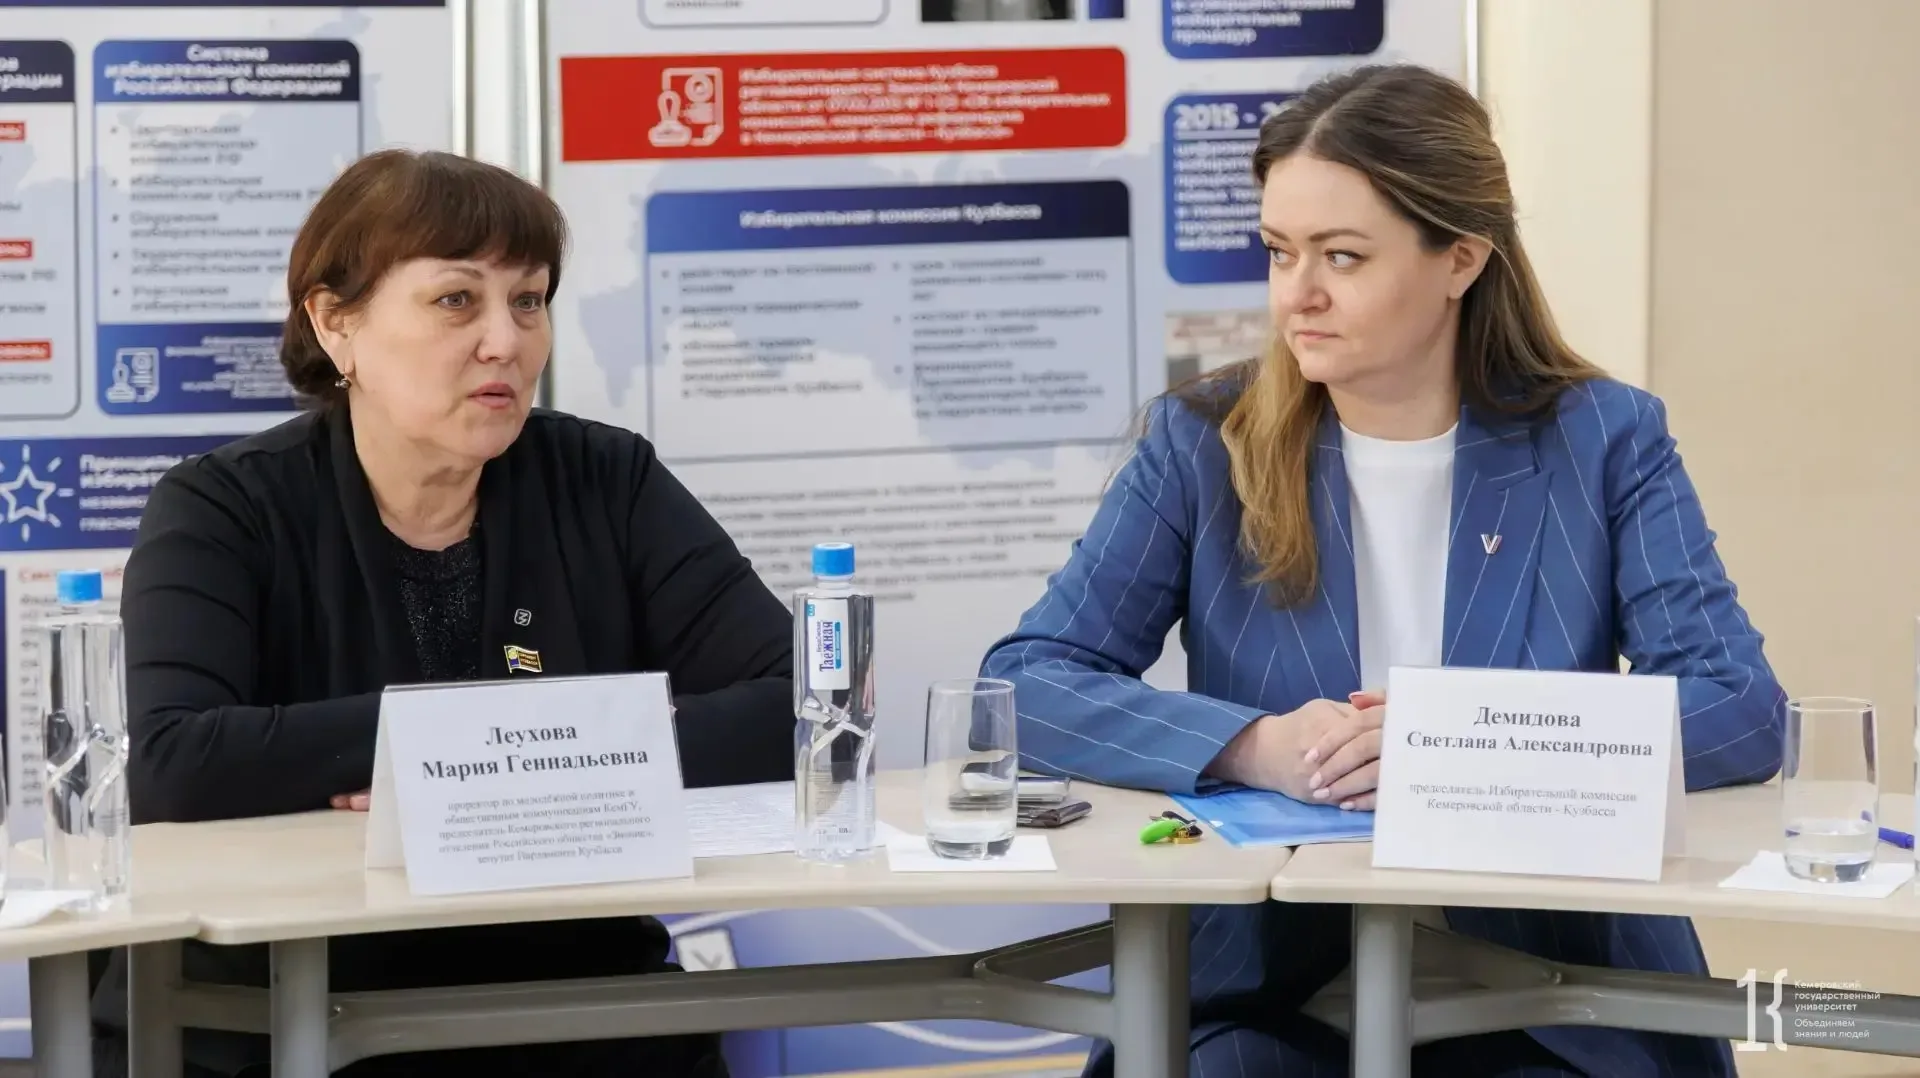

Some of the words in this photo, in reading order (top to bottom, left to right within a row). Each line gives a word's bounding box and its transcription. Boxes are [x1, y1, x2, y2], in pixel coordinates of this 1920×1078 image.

[1172, 28, 1257, 46] процедур
[187, 43, 269, 62] Система
[104, 61, 253, 79] избирательных
[255, 60, 350, 78] комиссий
[114, 78, 229, 95] Российской
[231, 78, 342, 98] Федерации
[1174, 103, 1239, 129] 2015
[740, 211, 873, 230] Избирательная
[876, 206, 961, 223] комиссия
[962, 201, 1042, 225] Кузбасса
[1174, 235, 1250, 251] выборов
[80, 454, 184, 473] Принципы
[818, 621, 835, 673] Таежная
[1474, 706, 1581, 727] Демидова
[485, 726, 578, 748] Леухова
[1407, 731, 1497, 749] Светлана
[1504, 736, 1652, 758] Александровна
[422, 760, 499, 781] Мария
[505, 750, 648, 773] Геннадьевна
[1410, 783, 1485, 795] председатель
[1488, 785, 1578, 800] Избирательной
[1581, 791, 1637, 803] комиссии
[448, 799, 499, 812] проректор
[503, 798, 514, 808] по
[1427, 798, 1503, 813] Кемеровской
[1507, 802, 1552, 815] области
[1564, 804, 1616, 818] Кузбасса
[445, 811, 519, 826] общественным
[523, 805, 600, 821] коммуникациям
[439, 826, 504, 840] председатель
[507, 820, 577, 835] Кемеровского
[579, 815, 651, 830] регионального
[493, 835, 555, 849] Российского
[517, 848, 575, 862] Парламента
[579, 845, 623, 858] Кузбасса
